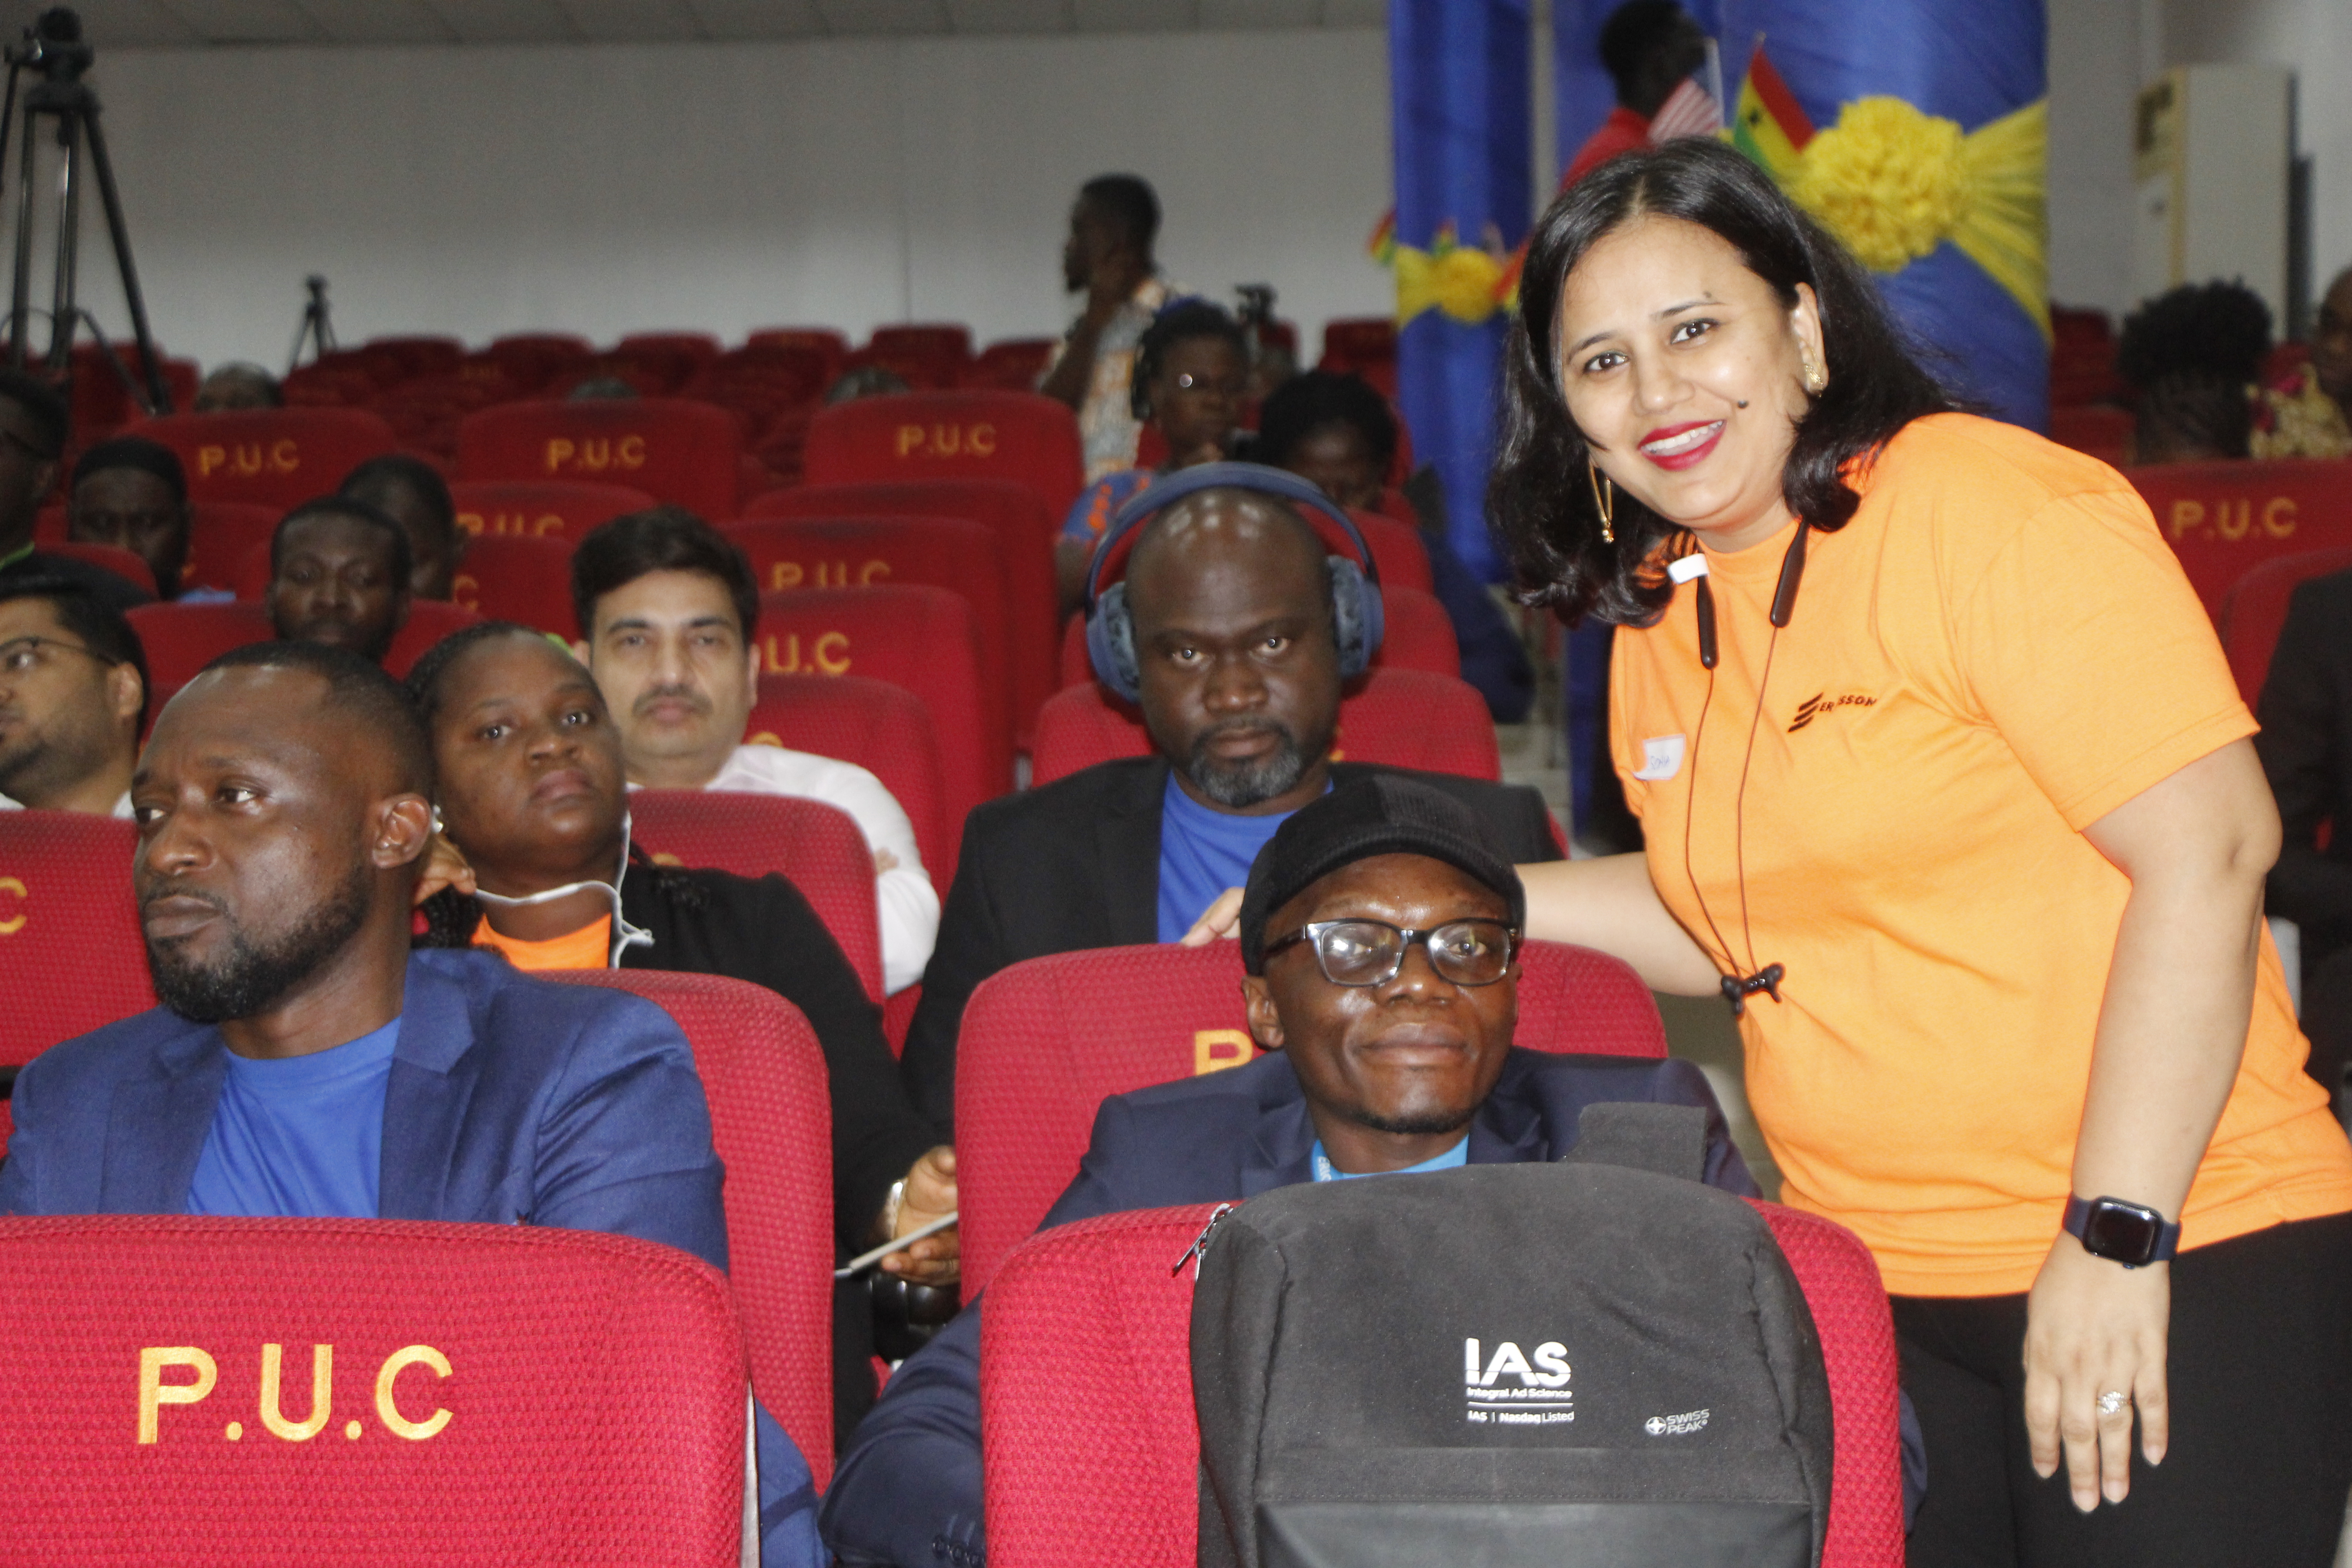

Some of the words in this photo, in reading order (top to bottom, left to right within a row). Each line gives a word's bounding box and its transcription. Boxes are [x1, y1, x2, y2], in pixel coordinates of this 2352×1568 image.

[546, 436, 645, 471] P.U.C
[896, 424, 996, 456] P.U.C
[2170, 497, 2297, 540] P.U.C
[771, 561, 890, 590] PUC
[765, 632, 852, 676] U.C
[1819, 694, 1877, 712] ERSSON
[1466, 1338, 1572, 1387] IAS
[137, 1343, 454, 1445] P.U.C
[1466, 1387, 1510, 1401] Integral
[1511, 1388, 1528, 1398] Ad
[1528, 1388, 1573, 1399] Science
[1468, 1410, 1488, 1423] IAS
[1499, 1412, 1542, 1424] Nasdaq
[1542, 1411, 1575, 1421] Listed
[1666, 1408, 1710, 1425] SWISS
